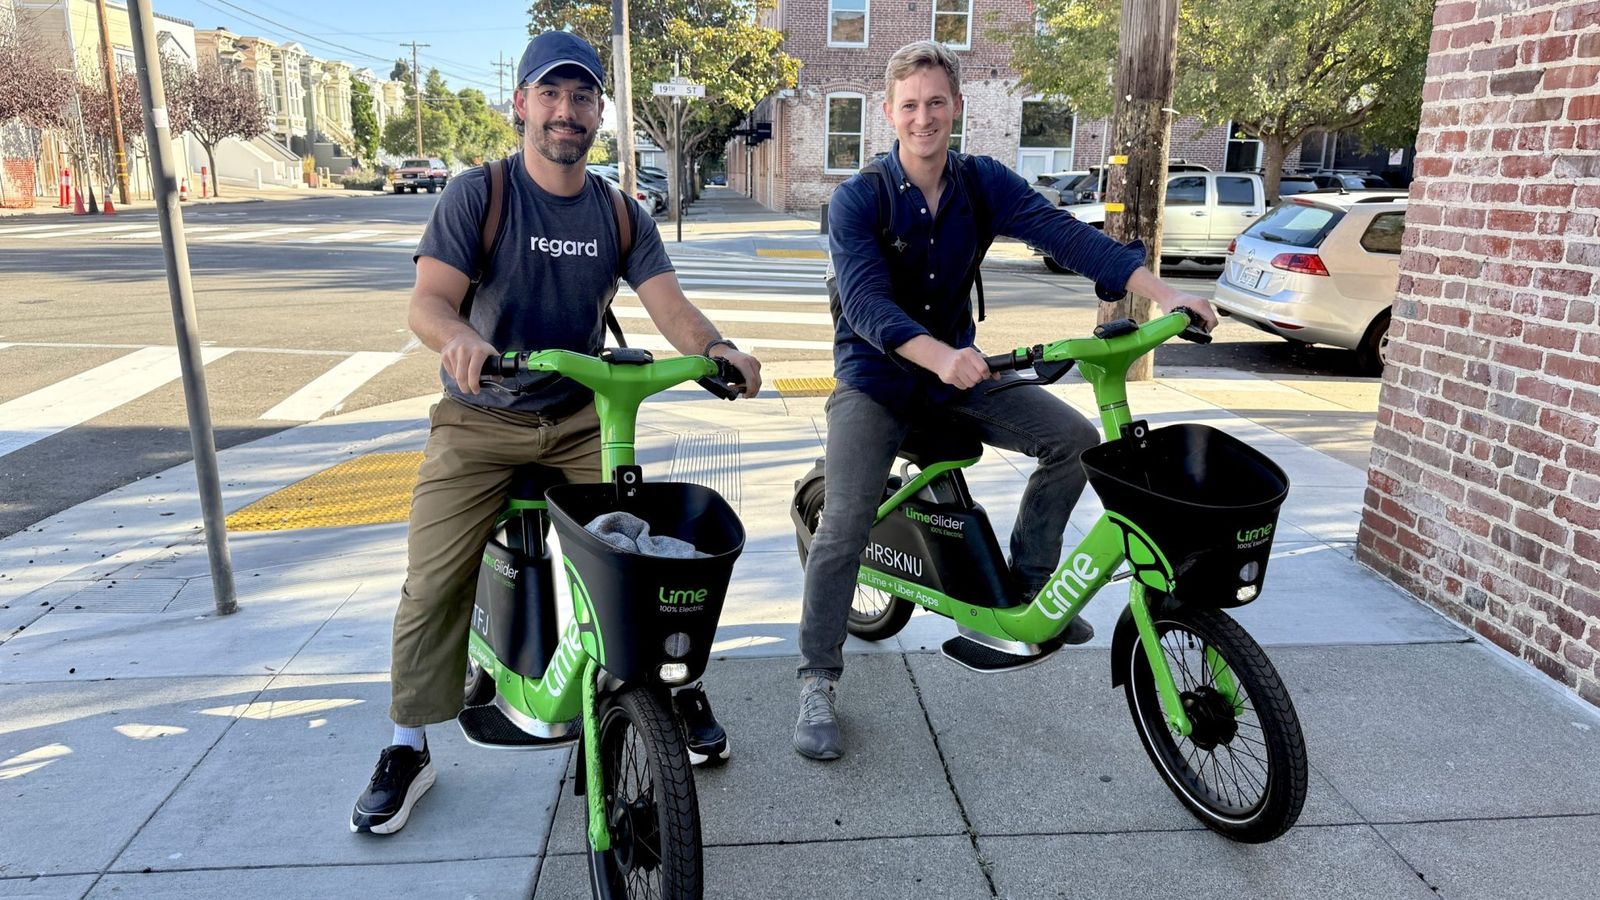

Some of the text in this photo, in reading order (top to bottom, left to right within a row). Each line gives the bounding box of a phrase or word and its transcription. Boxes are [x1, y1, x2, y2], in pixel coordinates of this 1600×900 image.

[659, 85, 698, 94] 19TH ST
[530, 236, 598, 258] regard
[905, 507, 965, 530] LimeGlider
[1236, 523, 1273, 542] Lime
[1237, 542, 1252, 550] 100%
[865, 541, 922, 577] HRSKNU
[659, 586, 708, 604] Lime
[868, 572, 886, 588] Lime
[894, 582, 914, 598] Uber
[915, 591, 939, 607] Apps
[1035, 552, 1099, 620] Lime
[659, 604, 704, 613] 100% Electric
[546, 616, 583, 697] Lime
